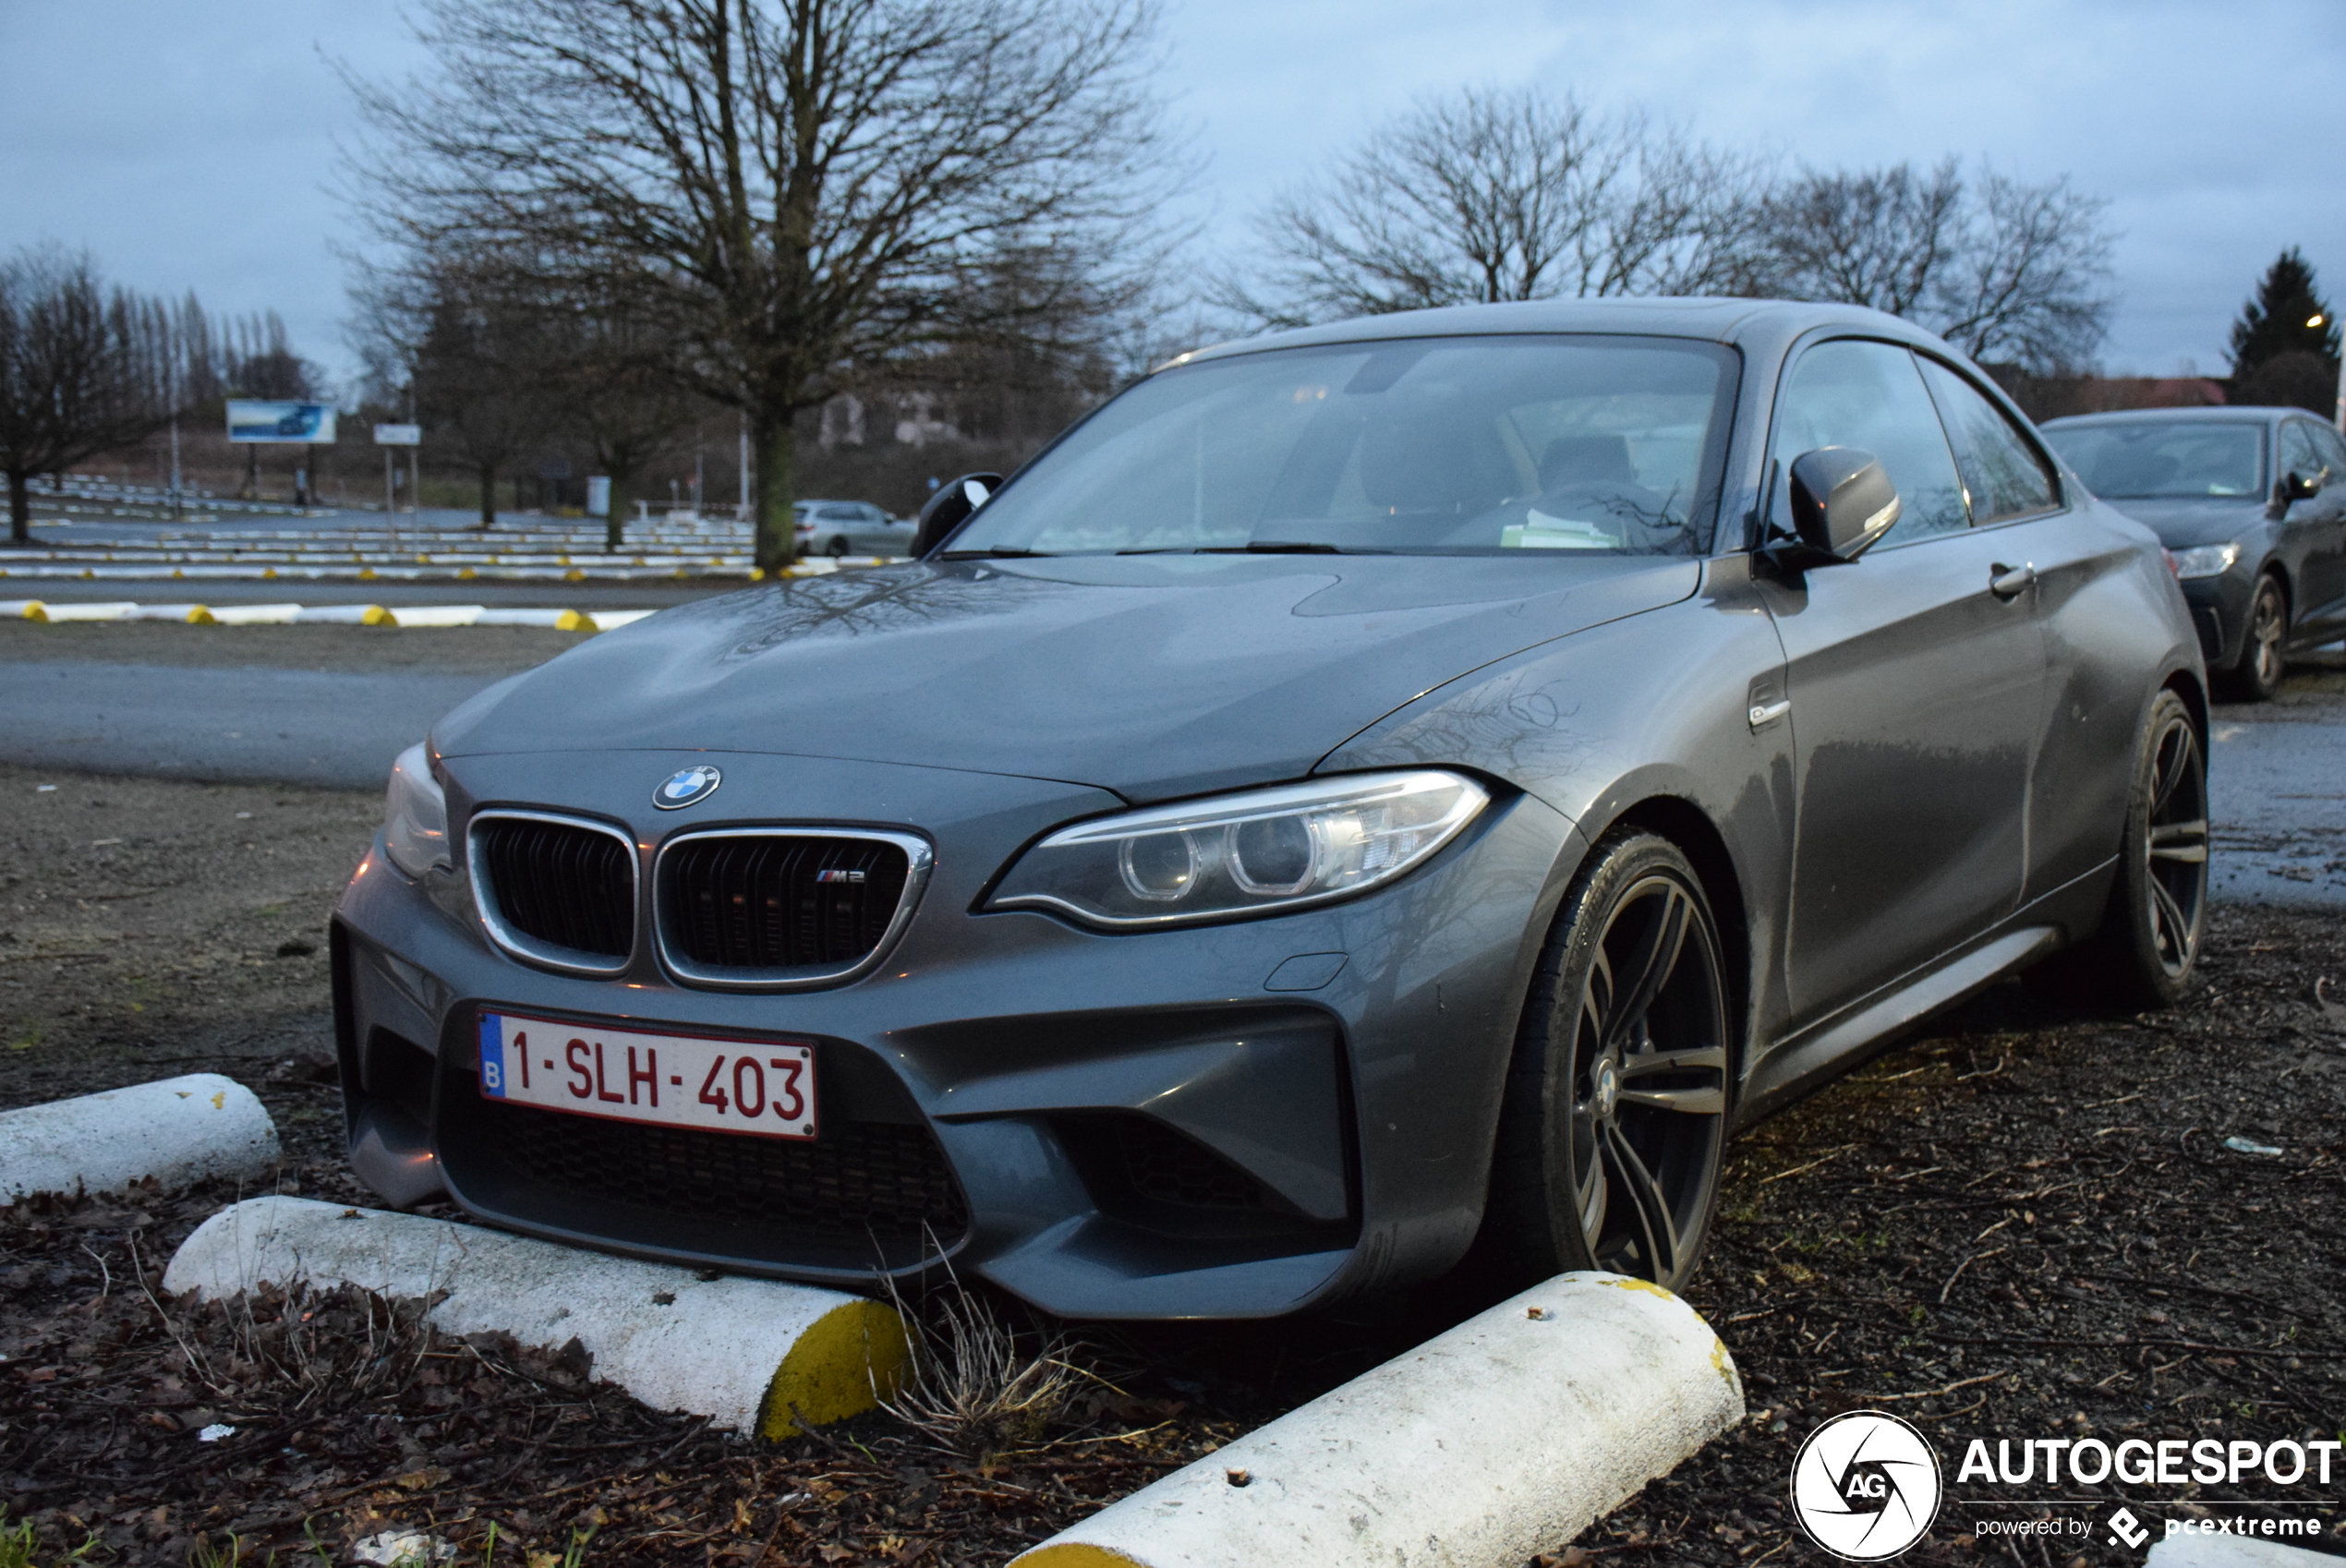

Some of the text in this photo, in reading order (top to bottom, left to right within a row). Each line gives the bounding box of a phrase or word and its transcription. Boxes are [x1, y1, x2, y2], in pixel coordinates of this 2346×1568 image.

[830, 870, 865, 883] M2
[485, 1061, 501, 1088] B
[513, 1031, 805, 1121] 1-SLH-403
